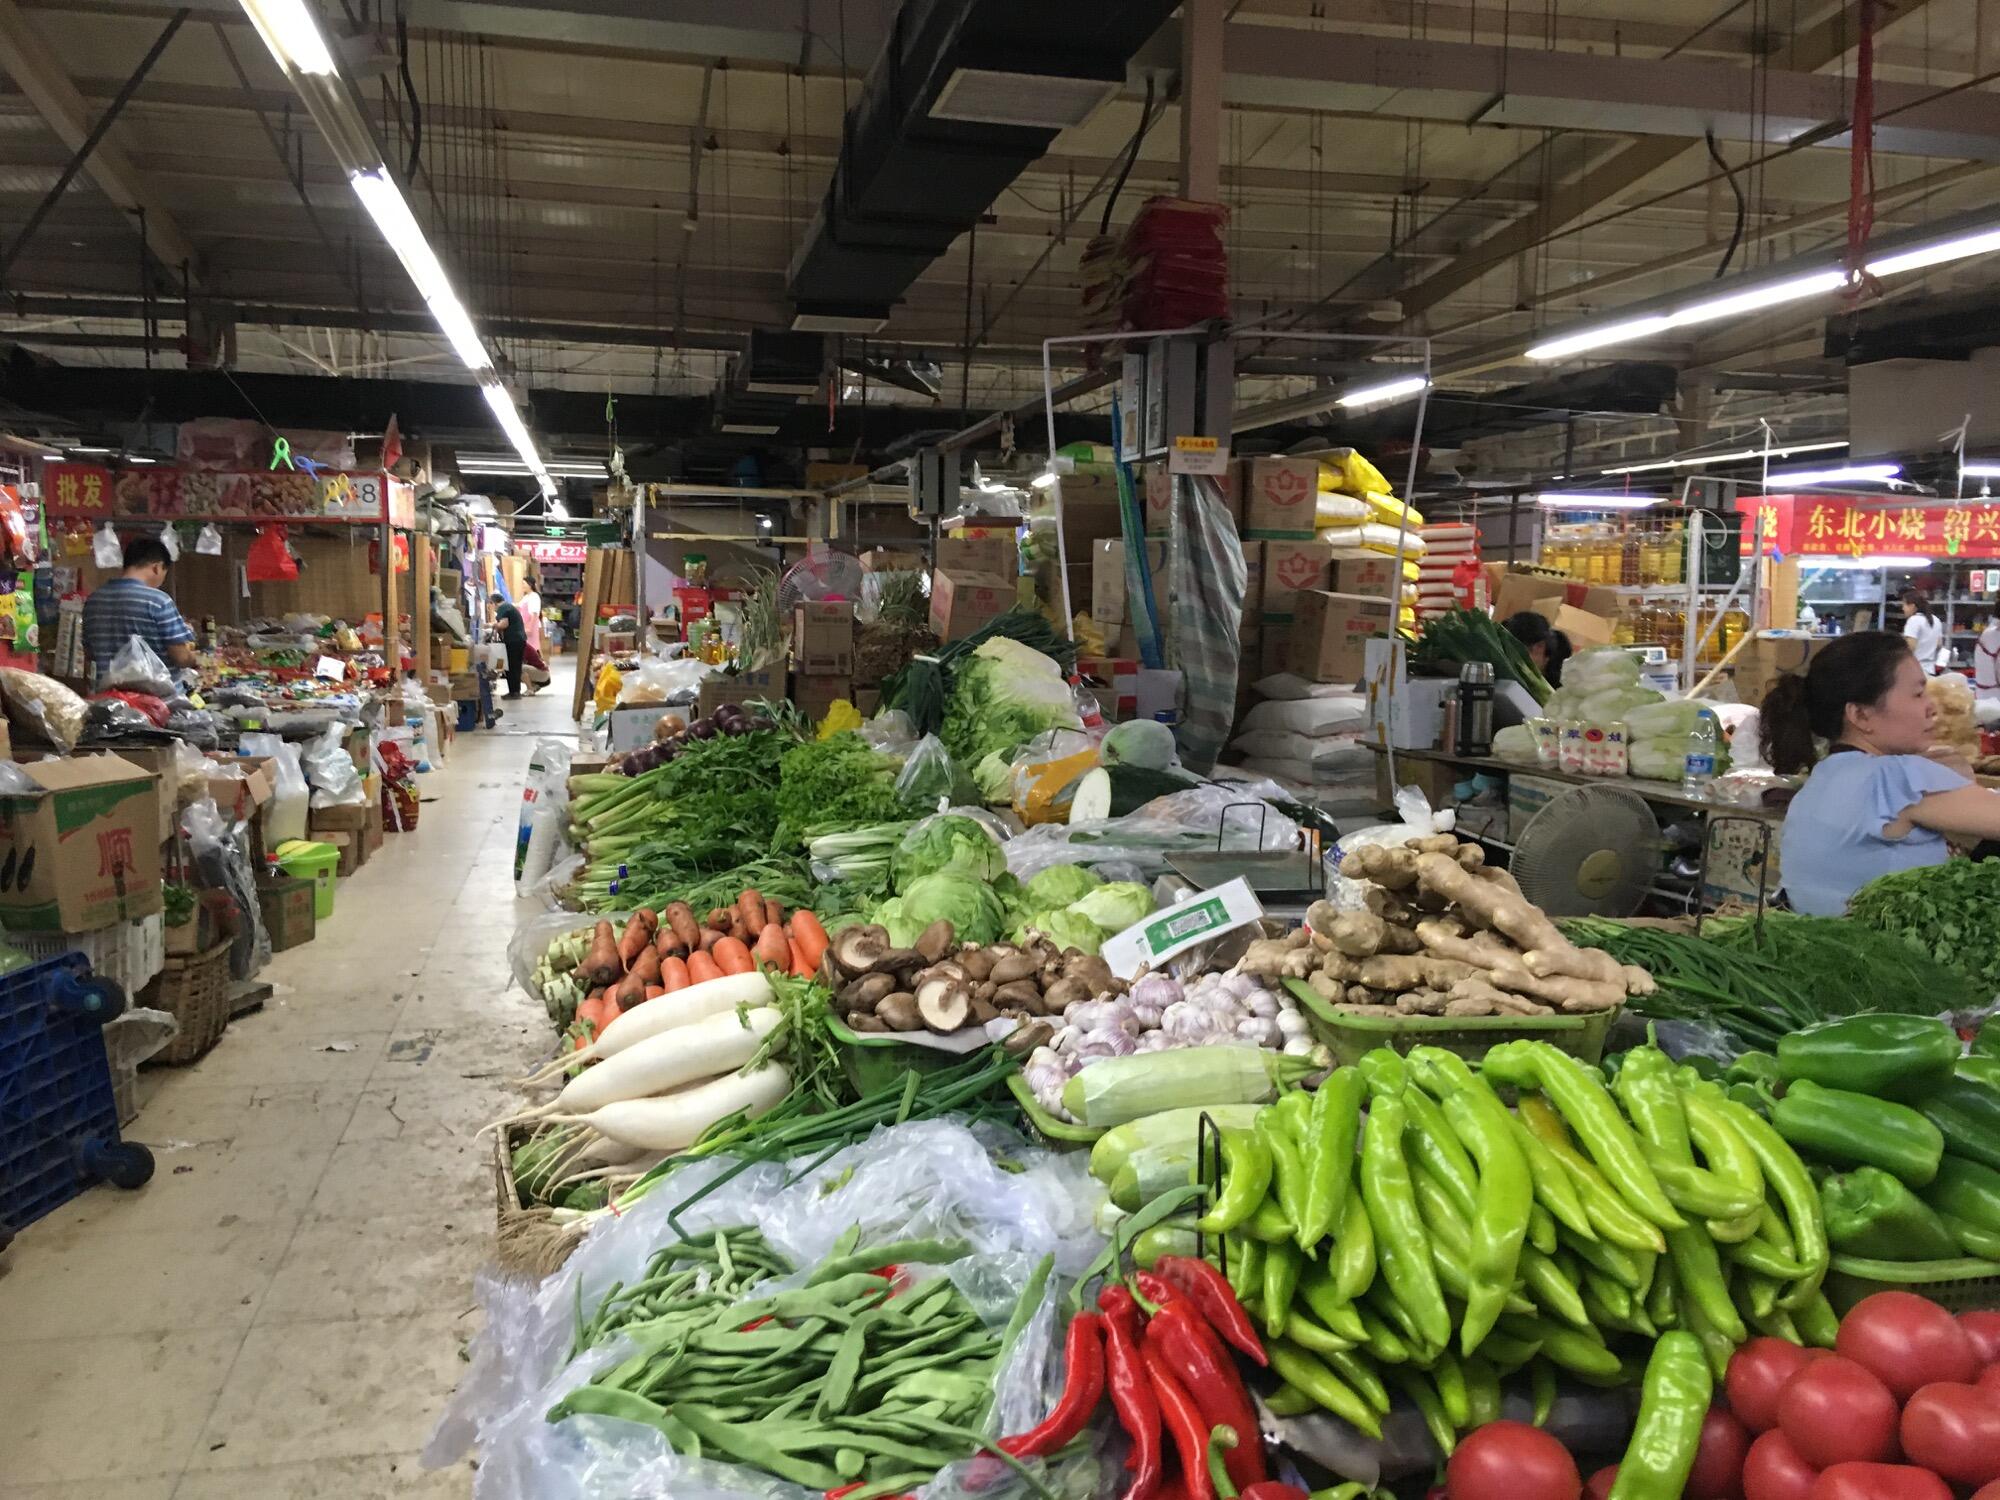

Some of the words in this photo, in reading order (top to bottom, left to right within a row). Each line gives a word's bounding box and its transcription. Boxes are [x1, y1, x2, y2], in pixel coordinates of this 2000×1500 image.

[56, 473, 105, 509] 批发
[1805, 503, 1926, 541] 东北小烧
